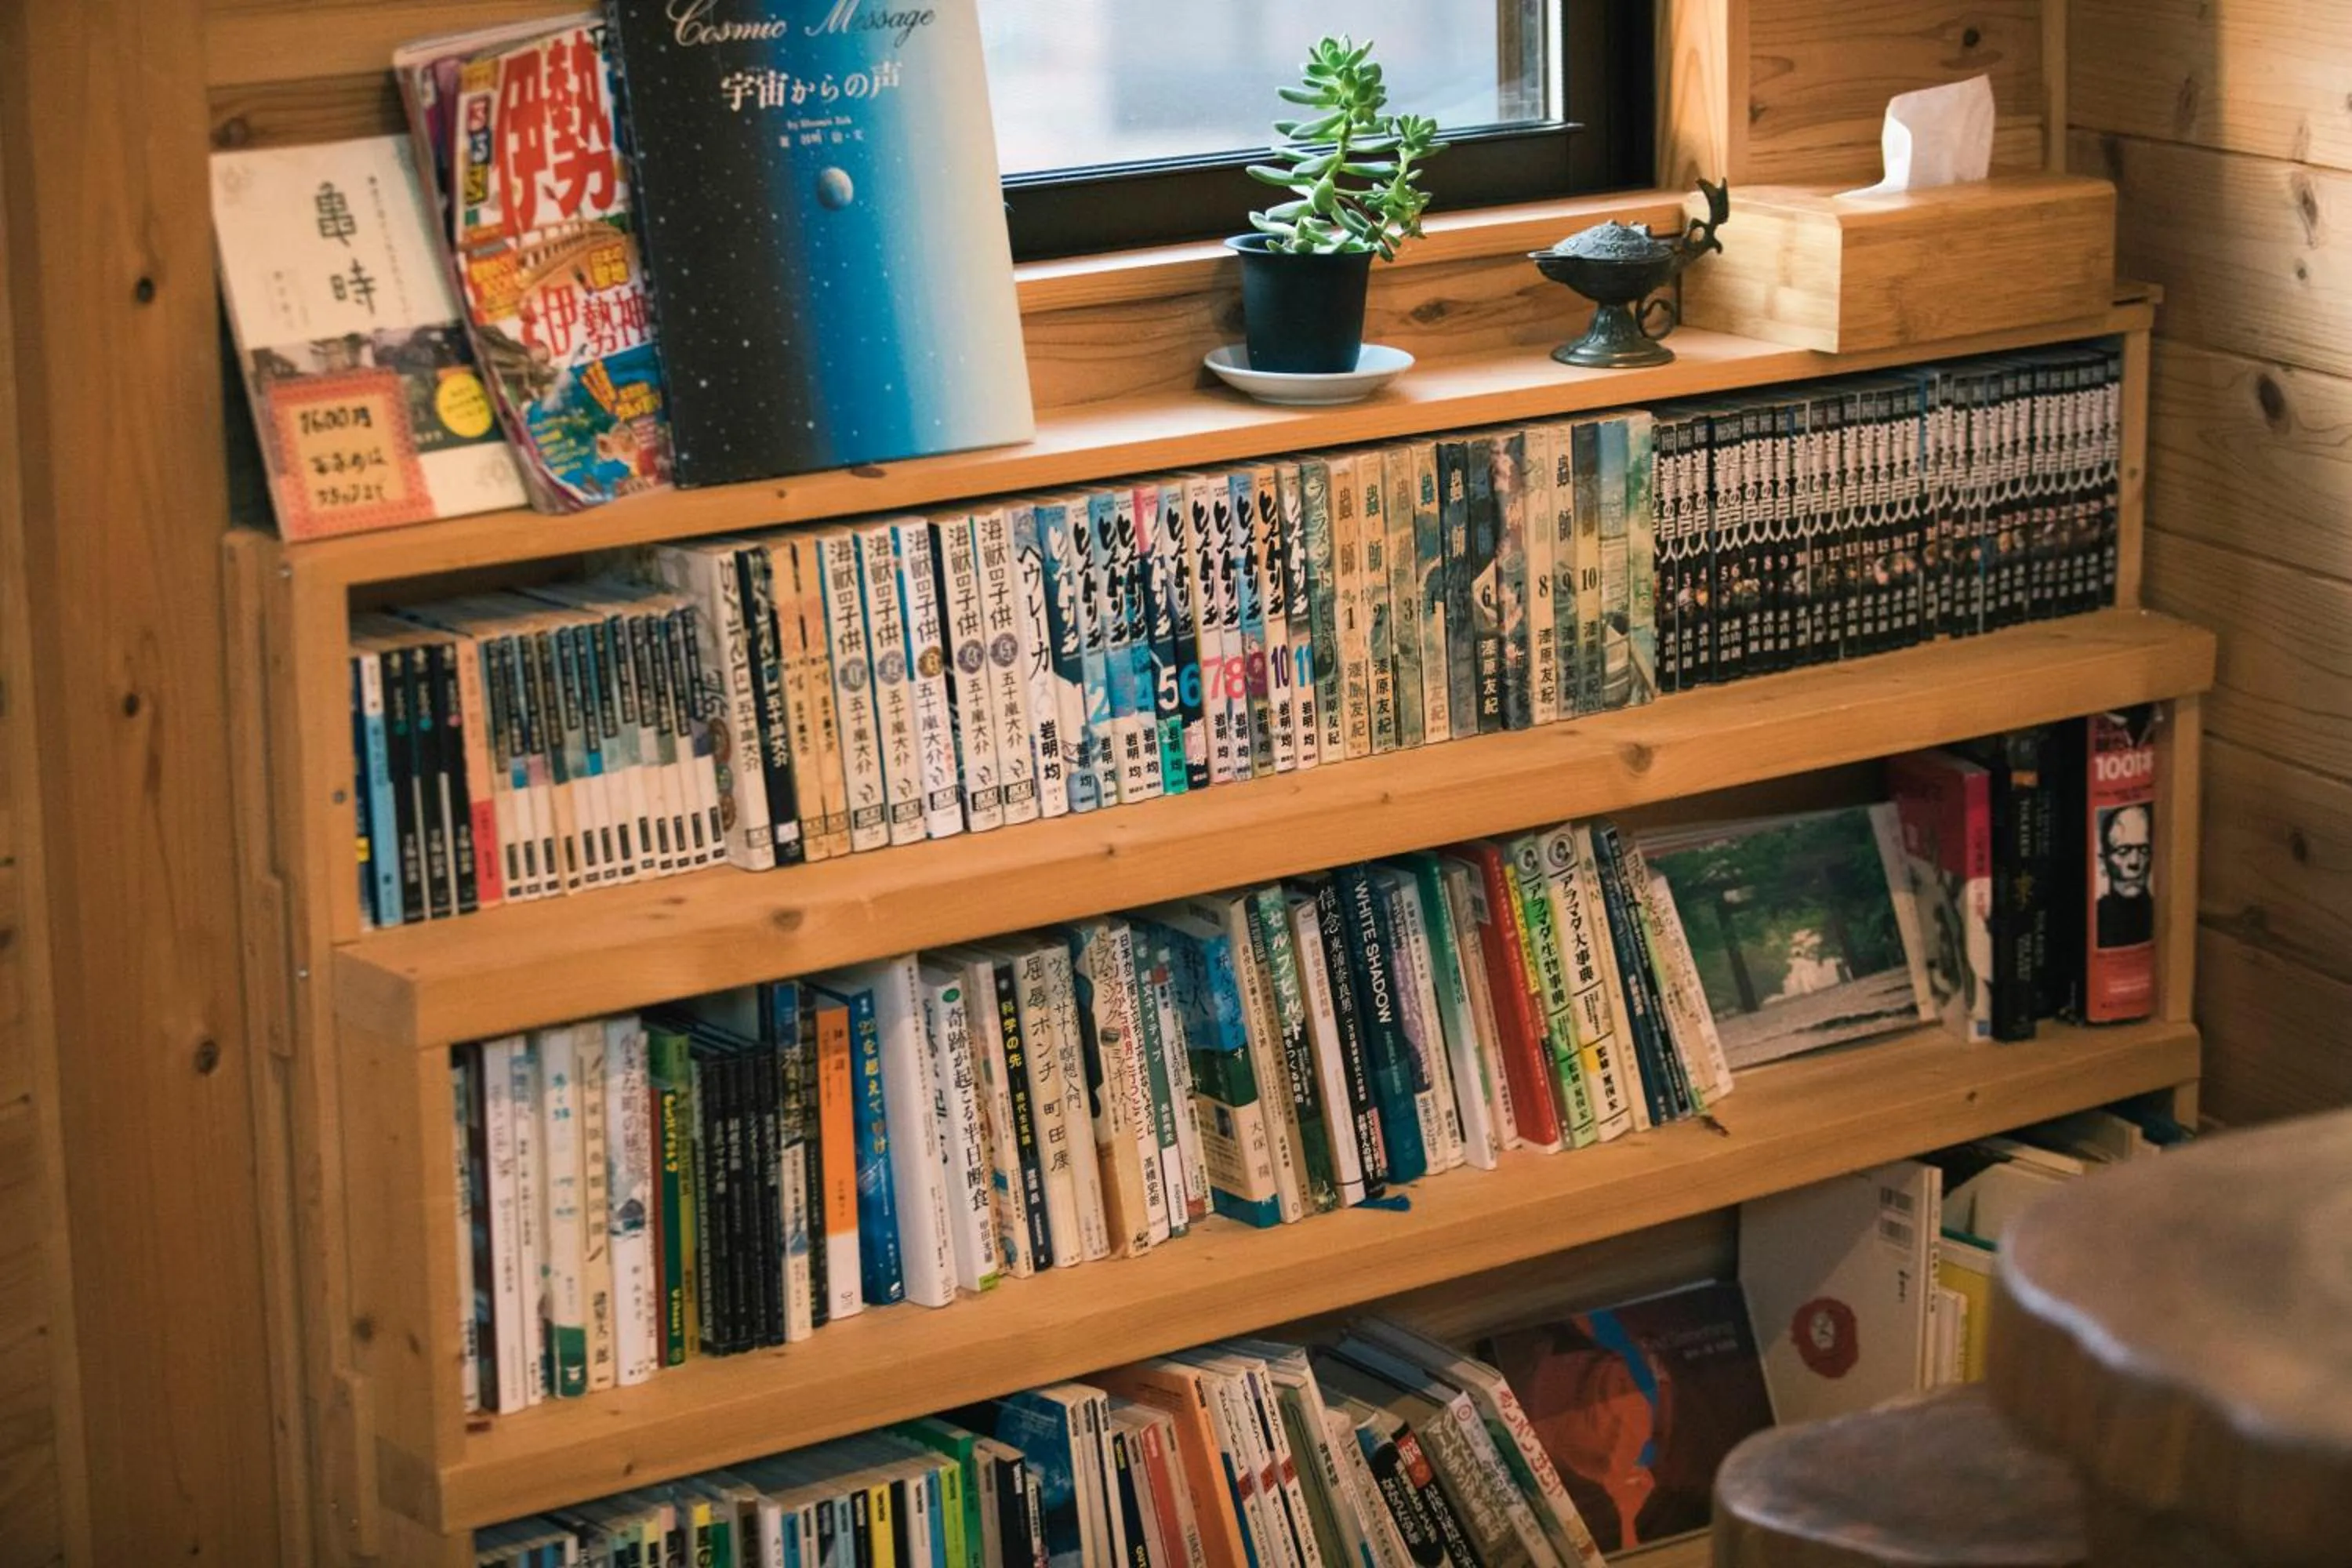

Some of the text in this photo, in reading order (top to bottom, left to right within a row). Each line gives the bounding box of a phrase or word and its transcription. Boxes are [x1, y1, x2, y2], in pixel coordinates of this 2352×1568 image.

[666, 0, 786, 47] Cosmic
[720, 61, 904, 112] 宇宙からの声
[495, 29, 615, 238] 伊勢
[868, 535, 899, 648] 海獣の子供
[908, 528, 939, 643] 海獣の子供
[949, 524, 980, 637] 海獣の子供
[981, 518, 1013, 630] 海獣の子供
[1048, 526, 1080, 654] ヒストリエ
[1073, 521, 1102, 648] ヒストリエ
[1098, 516, 1128, 642] ヒストリエ
[1116, 514, 1146, 641] ヒストリエ
[1146, 510, 1172, 637] ヒストリエ
[1192, 499, 1217, 626] ヒストリエ
[1214, 500, 1240, 626] ヒストリエ
[1236, 495, 1262, 620] ヒストリエ
[1258, 490, 1283, 615] ヒストリエ
[1283, 489, 1308, 615] ヒストリエ
[1538, 574, 1548, 598] 8
[1581, 566, 1597, 591] 10
[1721, 565, 1729, 580] 5
[1731, 564, 1740, 579] 6
[1748, 557, 1757, 573] 7
[1780, 555, 1788, 570] 9
[829, 539, 862, 654] 海獣の子供
[1018, 545, 1050, 681] ヘウレーカ
[1343, 607, 1355, 630] 1
[1157, 665, 1179, 710] 5
[1180, 662, 1201, 708] 6
[1202, 656, 1224, 699] 7
[1224, 655, 1246, 699] 8
[1271, 644, 1290, 689] 10
[1294, 642, 1315, 688] 11
[1538, 627, 1555, 704] 漆原友紀
[850, 695, 872, 775] 五十嵐大介
[889, 689, 910, 767] 五十嵐大介
[918, 682, 943, 764] 五十嵐大介
[967, 677, 989, 756] 五十嵐大介
[1000, 670, 1022, 749] 五十嵐大介
[1040, 719, 1062, 781] 岩明均
[1143, 727, 1160, 774] 岩明均
[1319, 885, 1341, 935] 信念
[1528, 881, 1566, 1006] アラマタ生物事典
[1559, 873, 1595, 984] アラマタ大事典
[1355, 879, 1377, 943] WHITE
[1366, 944, 1393, 1024] SHADOW
[1044, 1098, 1070, 1172] 町田康
